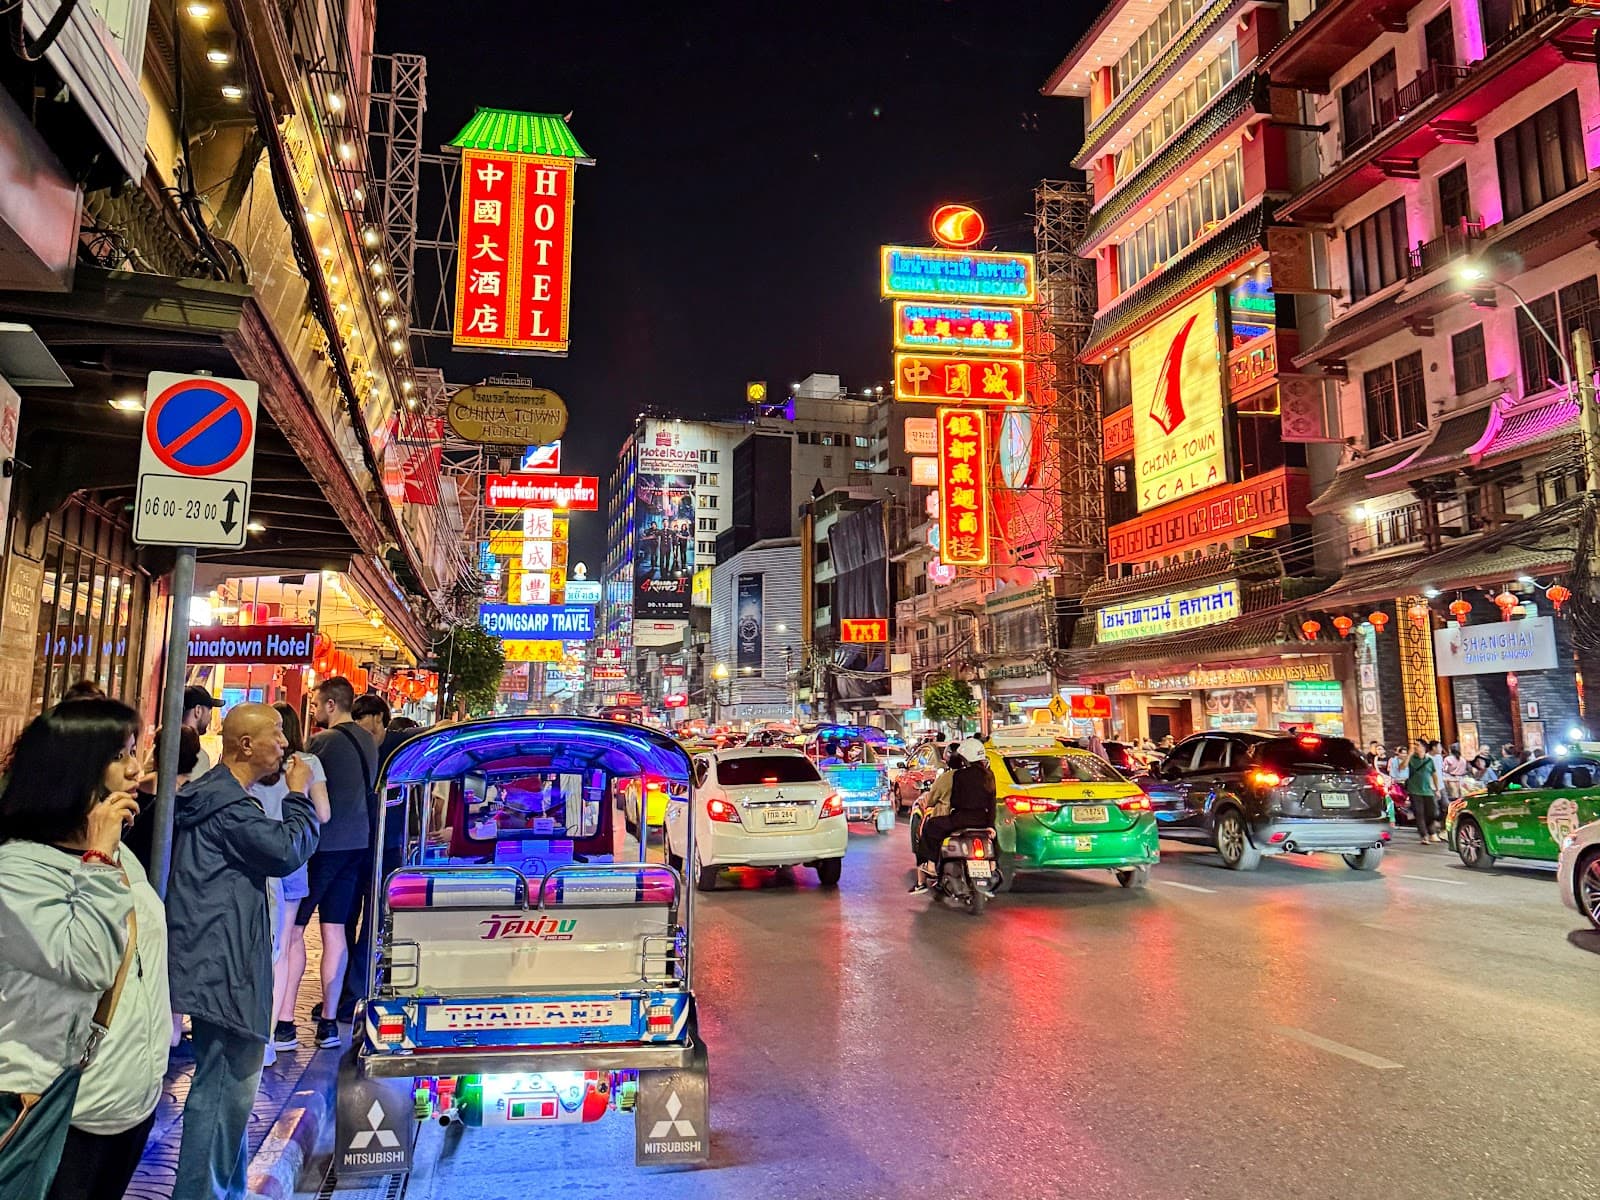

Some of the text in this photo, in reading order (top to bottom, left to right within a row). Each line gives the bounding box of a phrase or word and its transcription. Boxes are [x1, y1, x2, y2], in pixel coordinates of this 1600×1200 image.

[467, 163, 504, 333] 中國大酒店
[530, 170, 558, 337] HOTEL
[891, 276, 1027, 295] CHINA TOWN SCALA
[455, 406, 560, 425] CHINA TOWN
[482, 425, 533, 438] HOTEL
[1142, 431, 1216, 476] CHINA TOWN
[1143, 465, 1217, 506] SCALA
[19, 571, 30, 582] THE
[11, 583, 35, 602] CANTON
[11, 603, 31, 616] HOUSE
[1101, 583, 1233, 629] ไชน่าทาวน์ สกาล่า
[552, 613, 591, 631] TRAVEL
[187, 632, 310, 657] inatown Hotel
[1463, 631, 1533, 652] SHANGHAI
[1286, 663, 1329, 680] RESTAURANT
[445, 1004, 613, 1027] THAILAND
[645, 1141, 701, 1154] MITSUBISHI
[344, 1151, 404, 1165] MITSUBISHI
